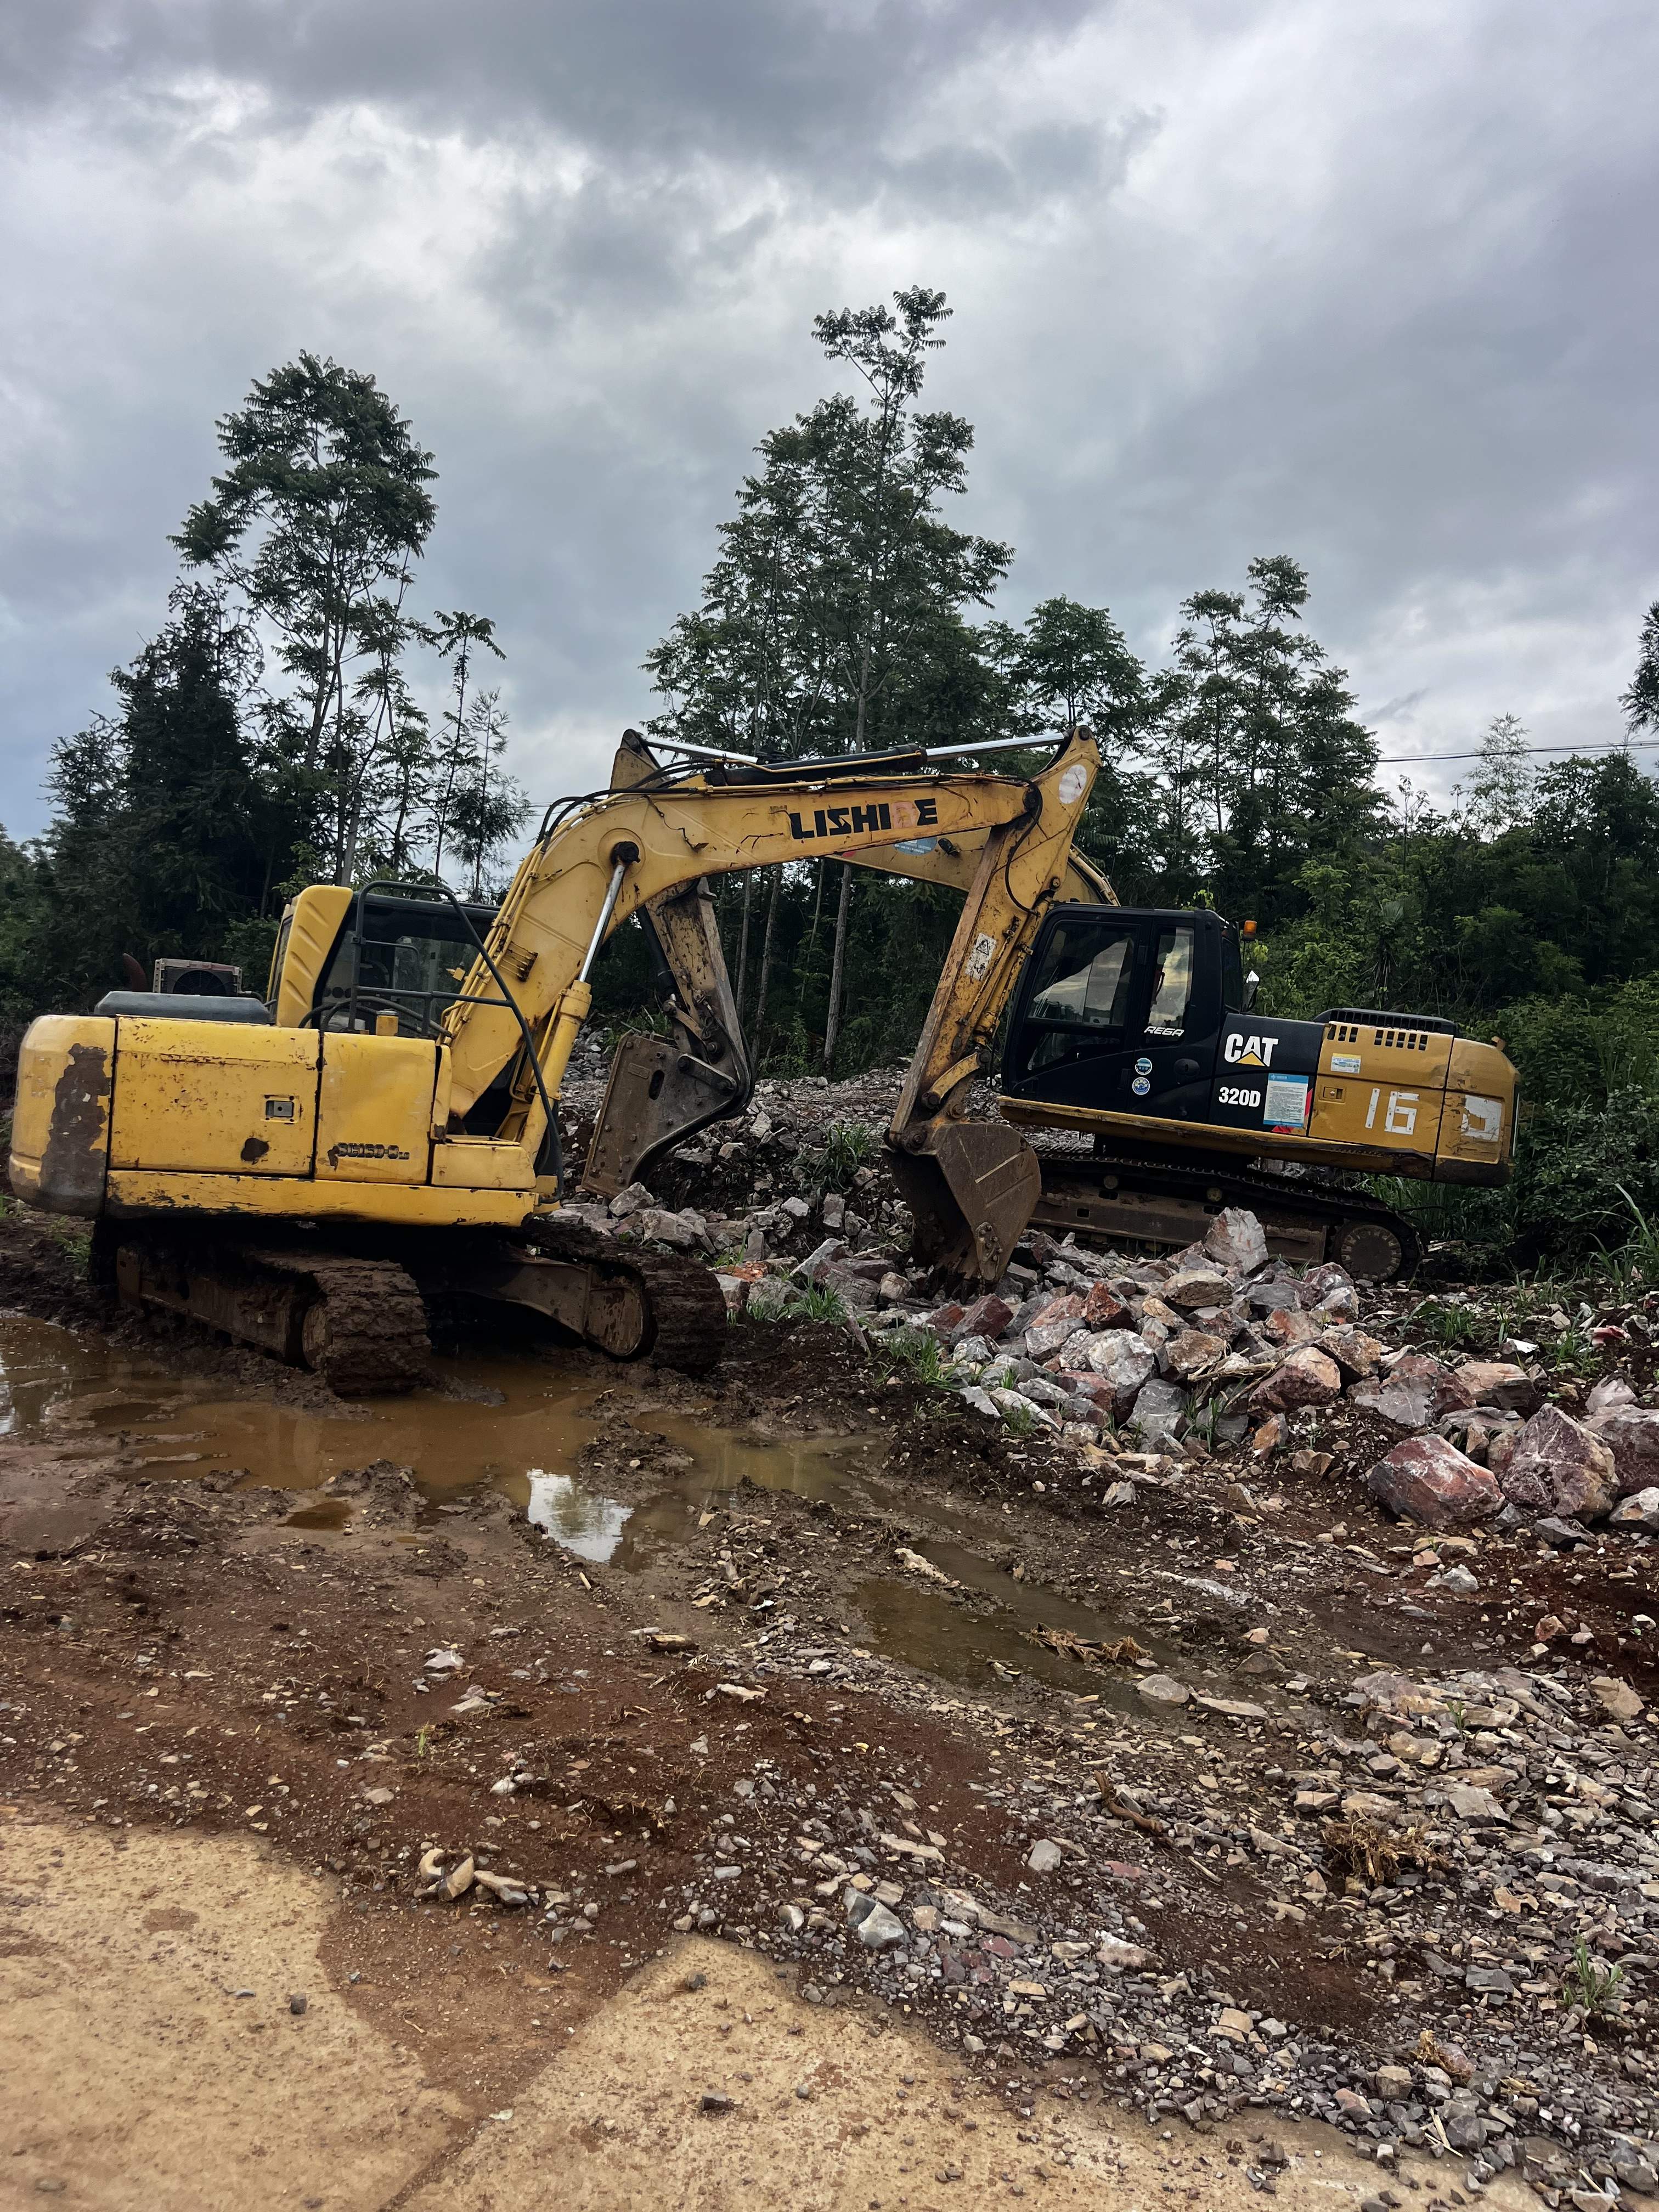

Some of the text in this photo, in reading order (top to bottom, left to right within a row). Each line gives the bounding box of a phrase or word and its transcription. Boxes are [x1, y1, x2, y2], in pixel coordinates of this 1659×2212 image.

[1143, 1025, 1185, 1037] REGA
[1224, 1033, 1279, 1067] CAT
[1218, 1086, 1261, 1107] 320D
[1364, 1088, 1420, 1135] 16
